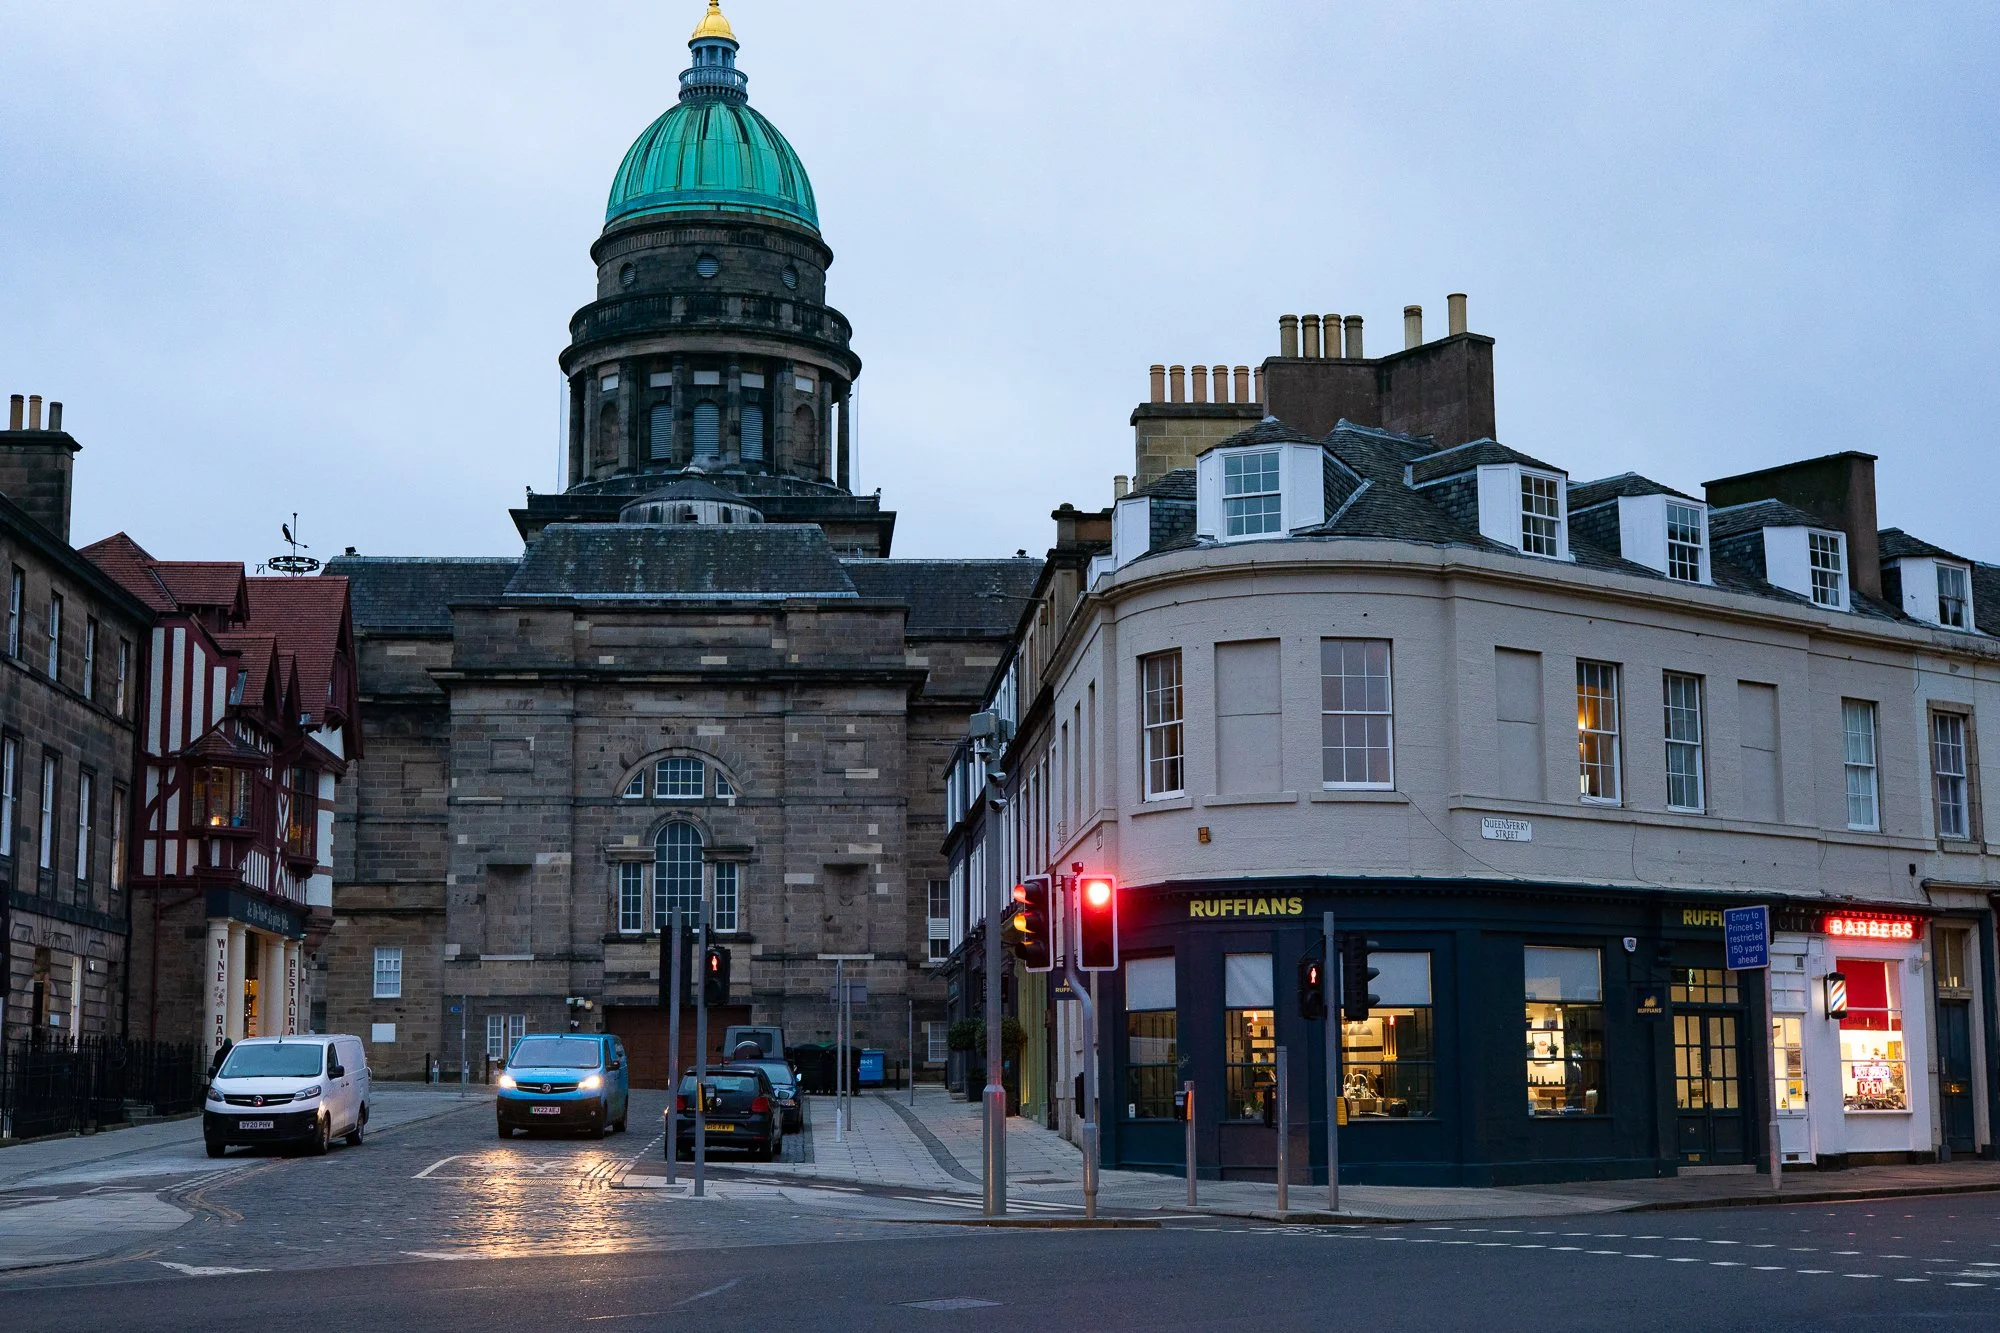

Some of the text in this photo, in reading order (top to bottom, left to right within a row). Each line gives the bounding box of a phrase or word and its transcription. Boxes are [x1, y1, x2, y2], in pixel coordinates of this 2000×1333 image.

[1484, 820, 1528, 831] QUEENSFERRY
[1495, 830, 1519, 839] STREET
[1190, 897, 1303, 917] RUFFIANS
[1683, 909, 1725, 926] RUFFI
[1731, 911, 1759, 921] Entry to
[1728, 921, 1763, 932] Princes St
[1779, 914, 1913, 938] CITY BARBERS
[1729, 932, 1763, 943] restricted
[1731, 944, 1763, 954] 150 yards
[1737, 955, 1758, 964] ahead
[215, 938, 226, 1046] WINE BAR
[1860, 1081, 1883, 1095] OPEN
